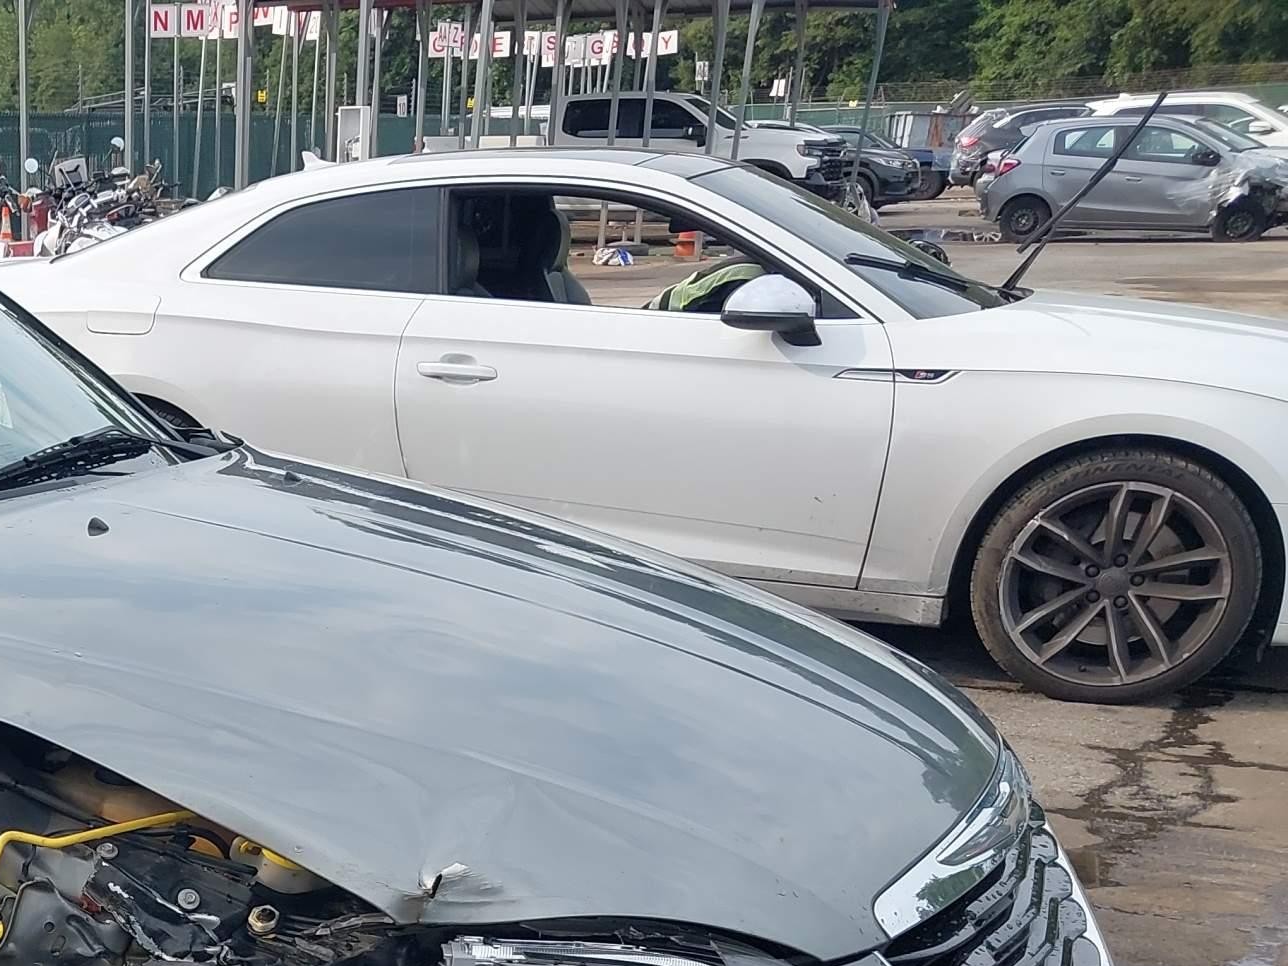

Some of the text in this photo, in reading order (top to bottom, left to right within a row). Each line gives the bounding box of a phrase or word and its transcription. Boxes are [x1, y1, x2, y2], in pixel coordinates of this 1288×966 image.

[153, 10, 168, 31] N
[186, 10, 204, 31] M
[229, 11, 240, 32] P
[493, 36, 504, 52] E
[591, 40, 603, 54] G
[661, 35, 672, 50] Y
